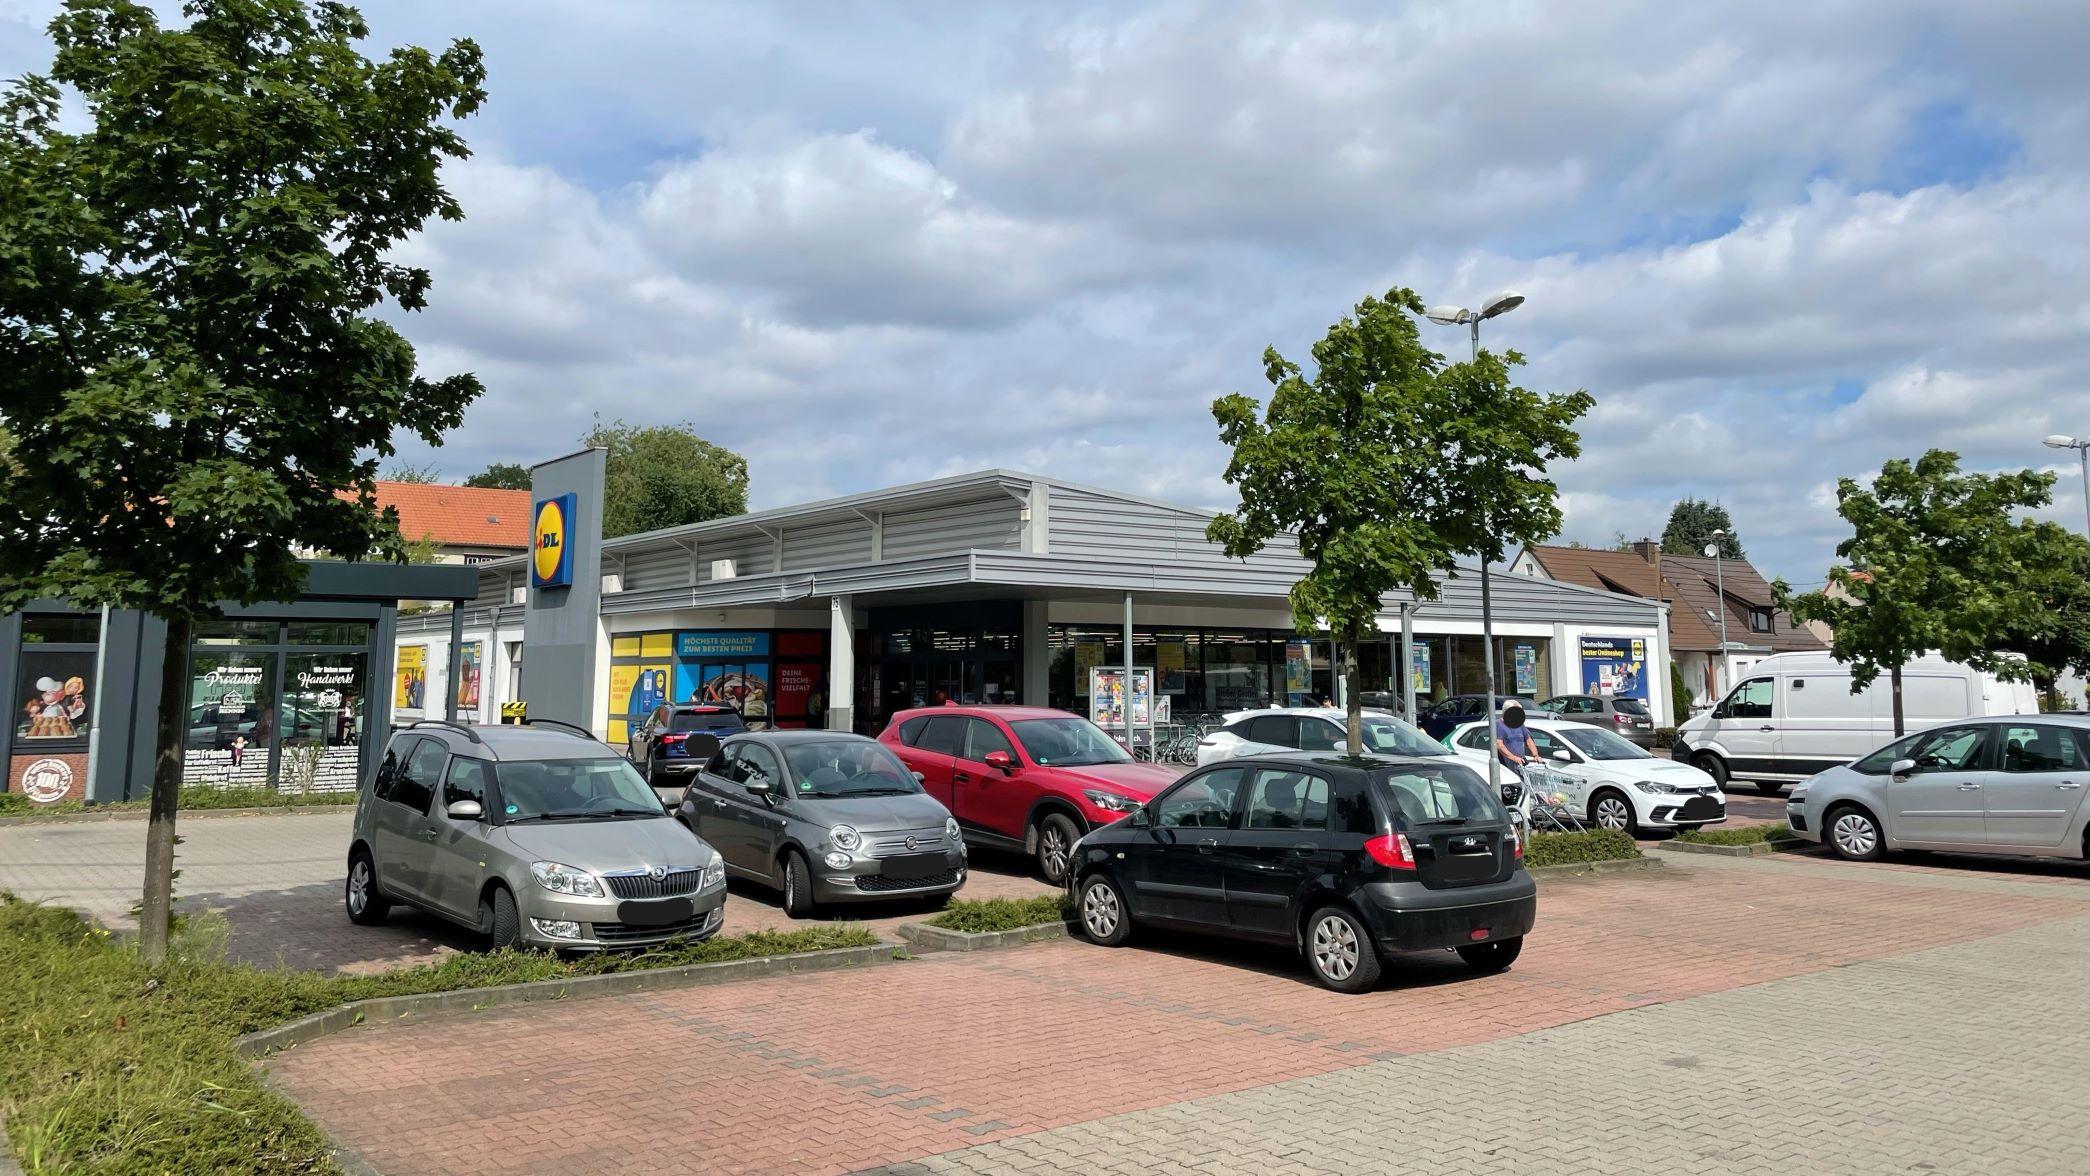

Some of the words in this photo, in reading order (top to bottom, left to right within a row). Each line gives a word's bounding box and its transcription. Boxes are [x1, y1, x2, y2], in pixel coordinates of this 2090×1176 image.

[832, 596, 839, 608] 75
[684, 637, 719, 645] HÖCHSTE
[720, 636, 756, 645] QUALITÄT
[1581, 640, 1614, 648] Deutschlands
[683, 645, 701, 653] ZUM
[702, 645, 730, 653] BESTEN
[731, 645, 753, 653] PREIS
[1597, 649, 1625, 658] Onlineshop
[204, 671, 263, 688] Produkte!
[297, 671, 355, 689] Handwerk!
[781, 684, 810, 692] VIELFALT
[201, 749, 232, 759] Frische
